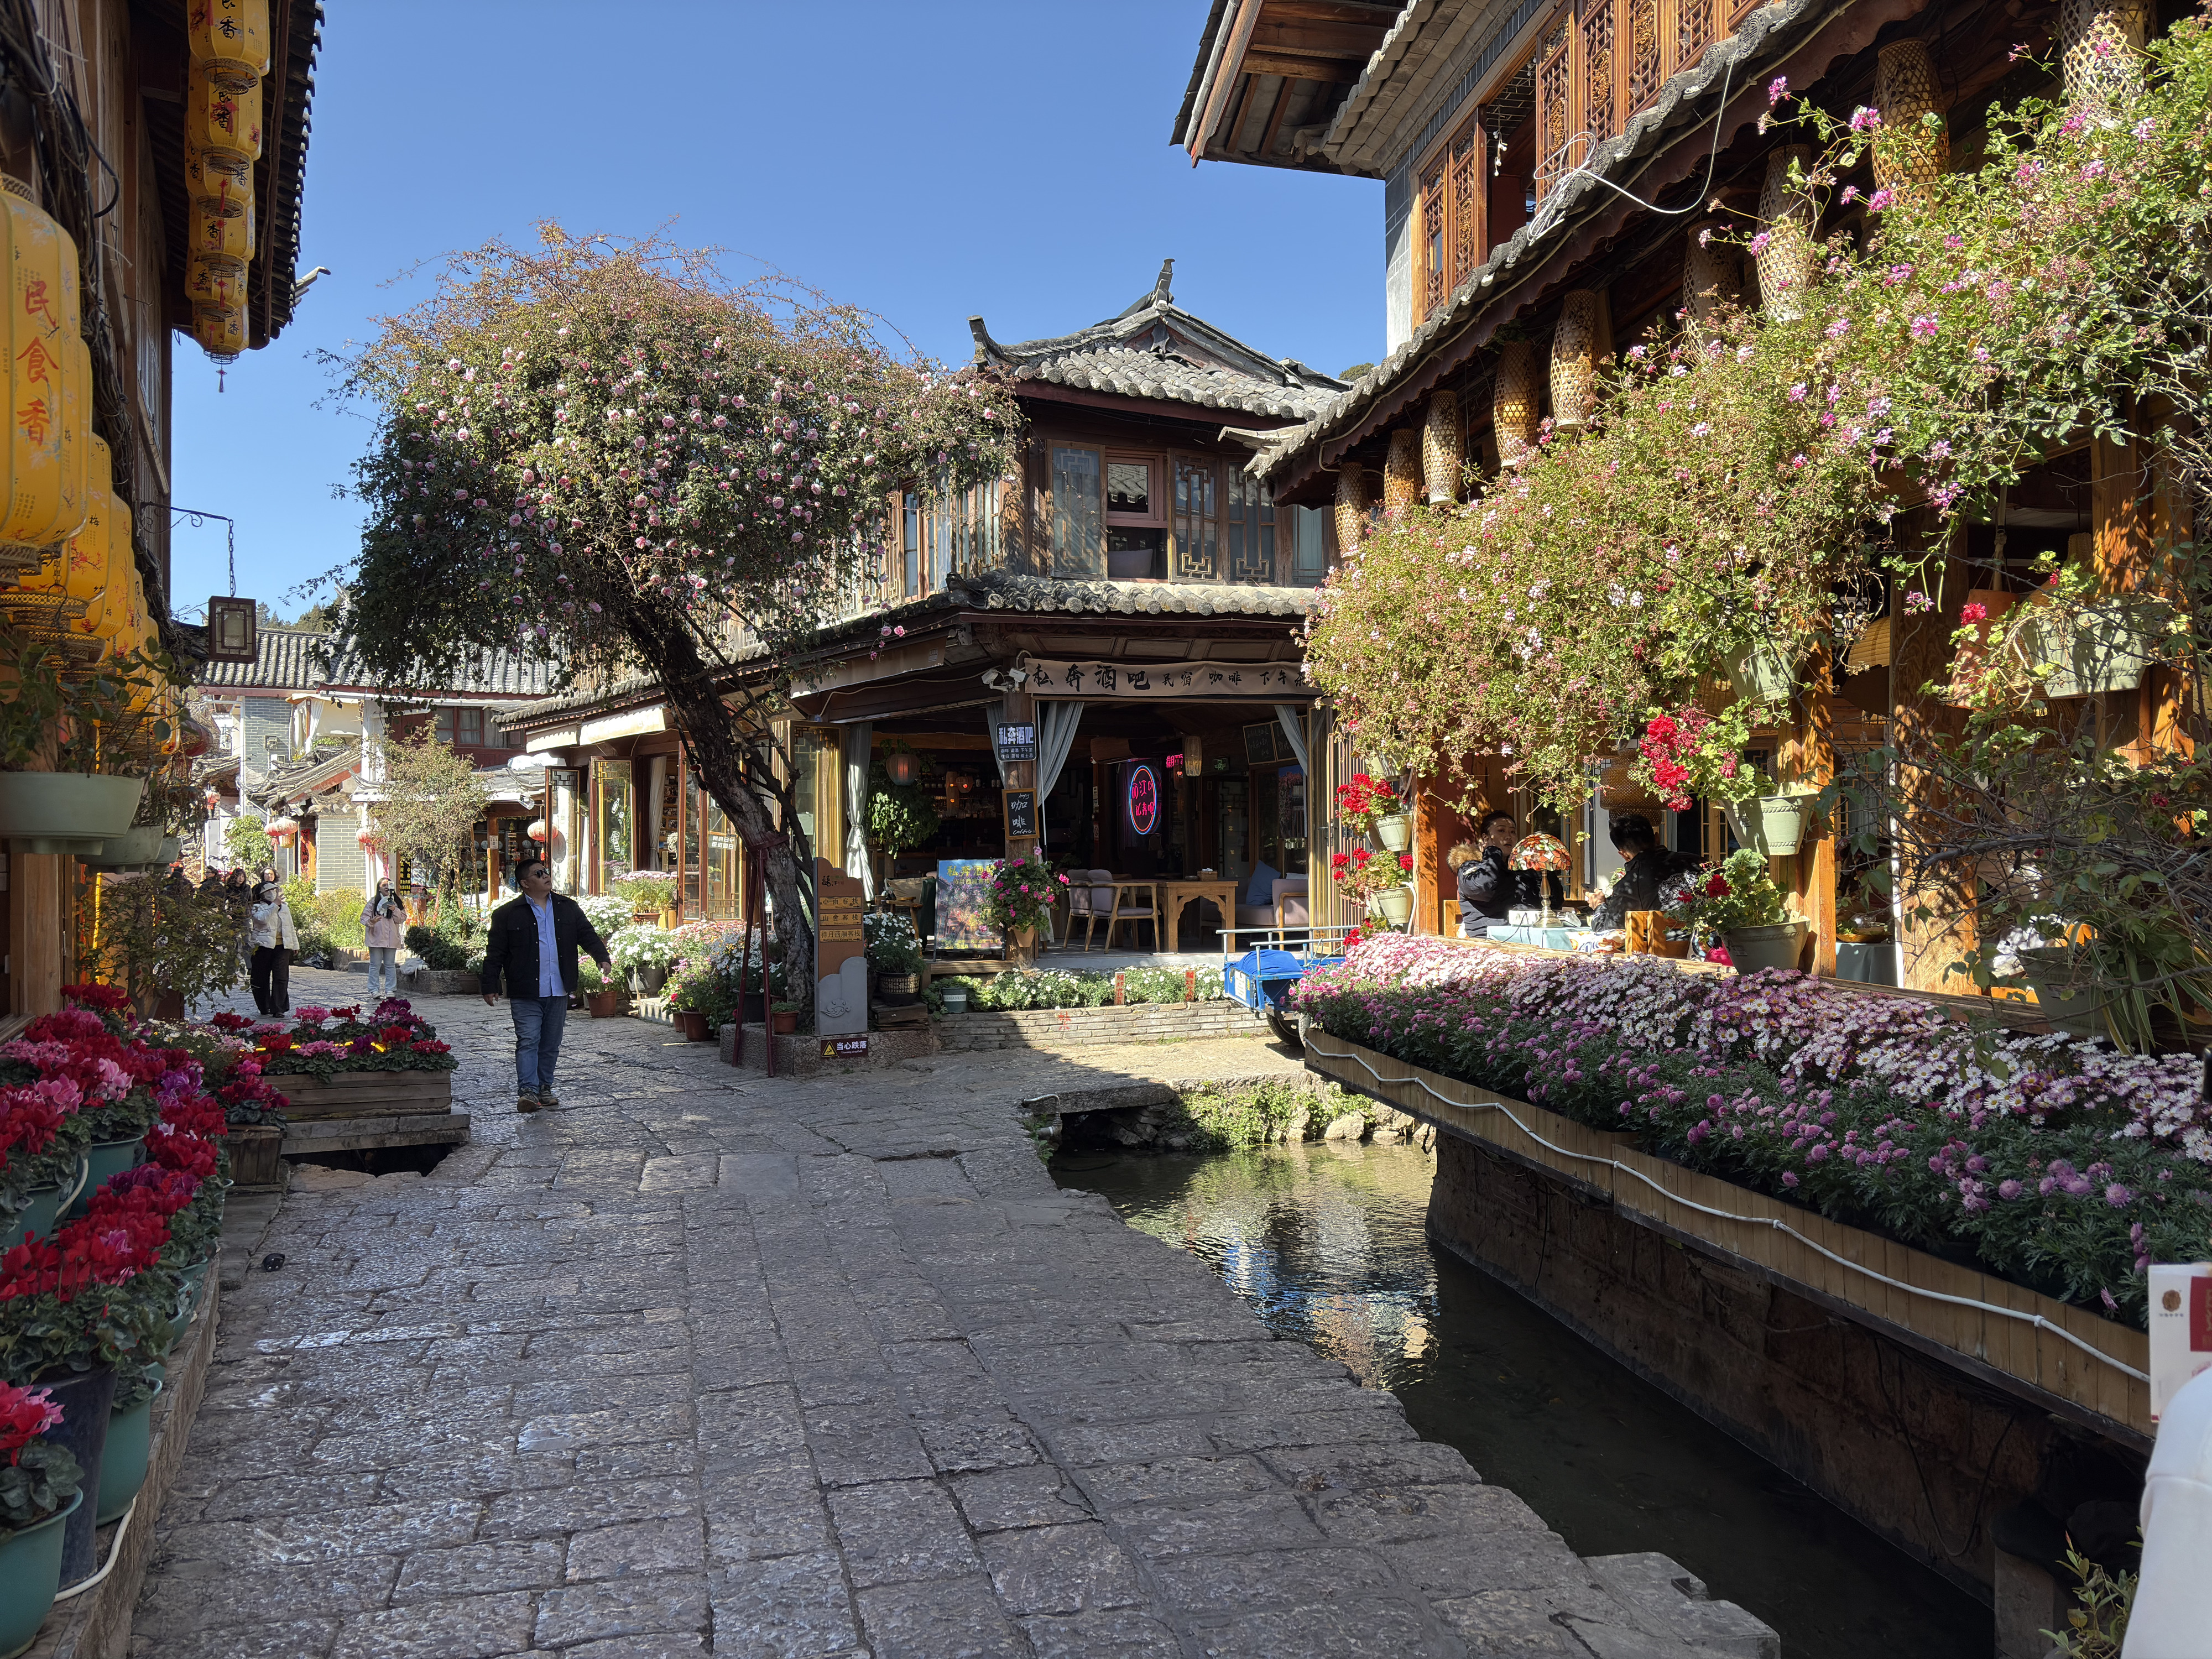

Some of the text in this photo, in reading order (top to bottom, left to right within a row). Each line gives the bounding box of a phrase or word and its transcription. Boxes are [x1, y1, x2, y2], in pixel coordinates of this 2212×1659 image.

[1032, 664, 1151, 692] 私奔酒吧
[1162, 671, 1193, 687] 民宿
[1209, 670, 1242, 686] 咖啡
[999, 727, 1034, 744] 私奔酒吧
[837, 1040, 867, 1050] 当心跌落
